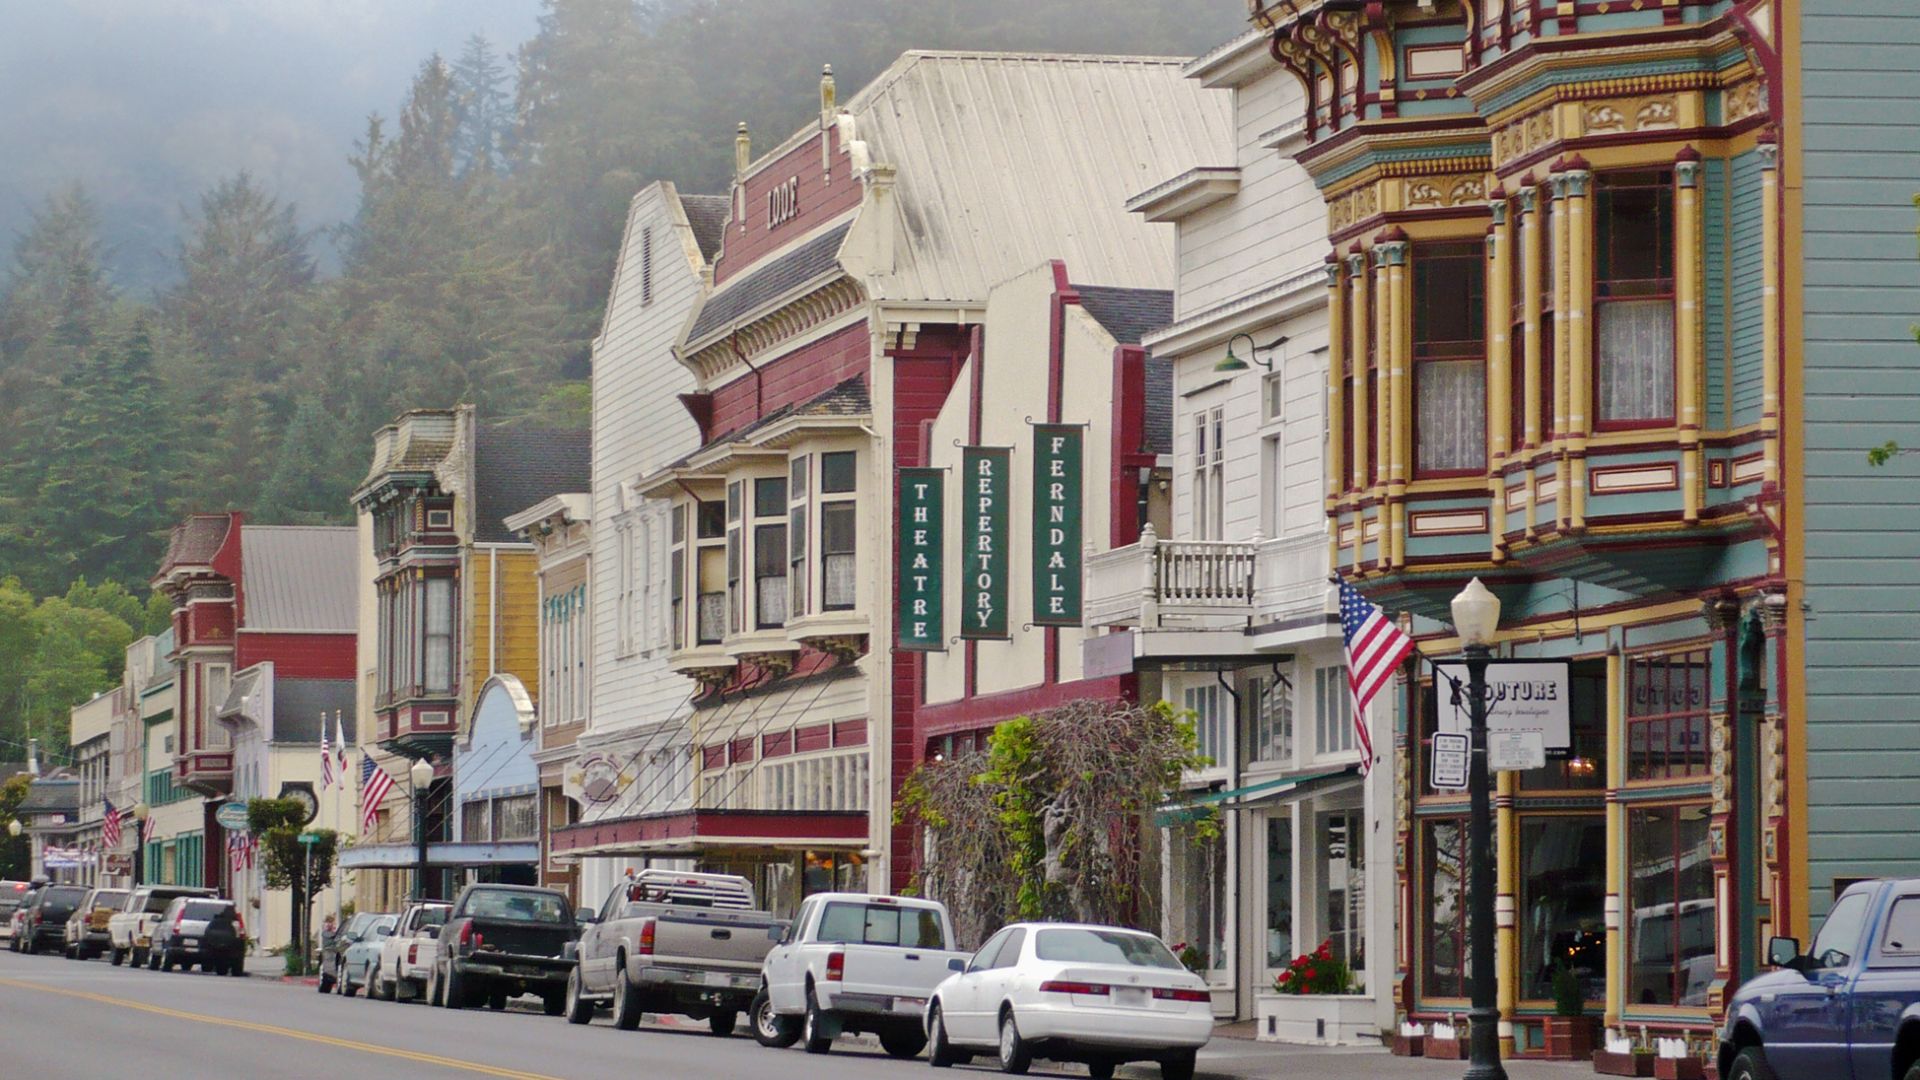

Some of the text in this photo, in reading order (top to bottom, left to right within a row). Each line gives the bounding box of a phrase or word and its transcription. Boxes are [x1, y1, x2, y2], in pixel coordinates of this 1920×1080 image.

[912, 484, 929, 638] THEATRE
[977, 459, 993, 628] REPERTORY
[1048, 437, 1065, 614] FERNDALE
[1484, 681, 1557, 701] OUTURE
